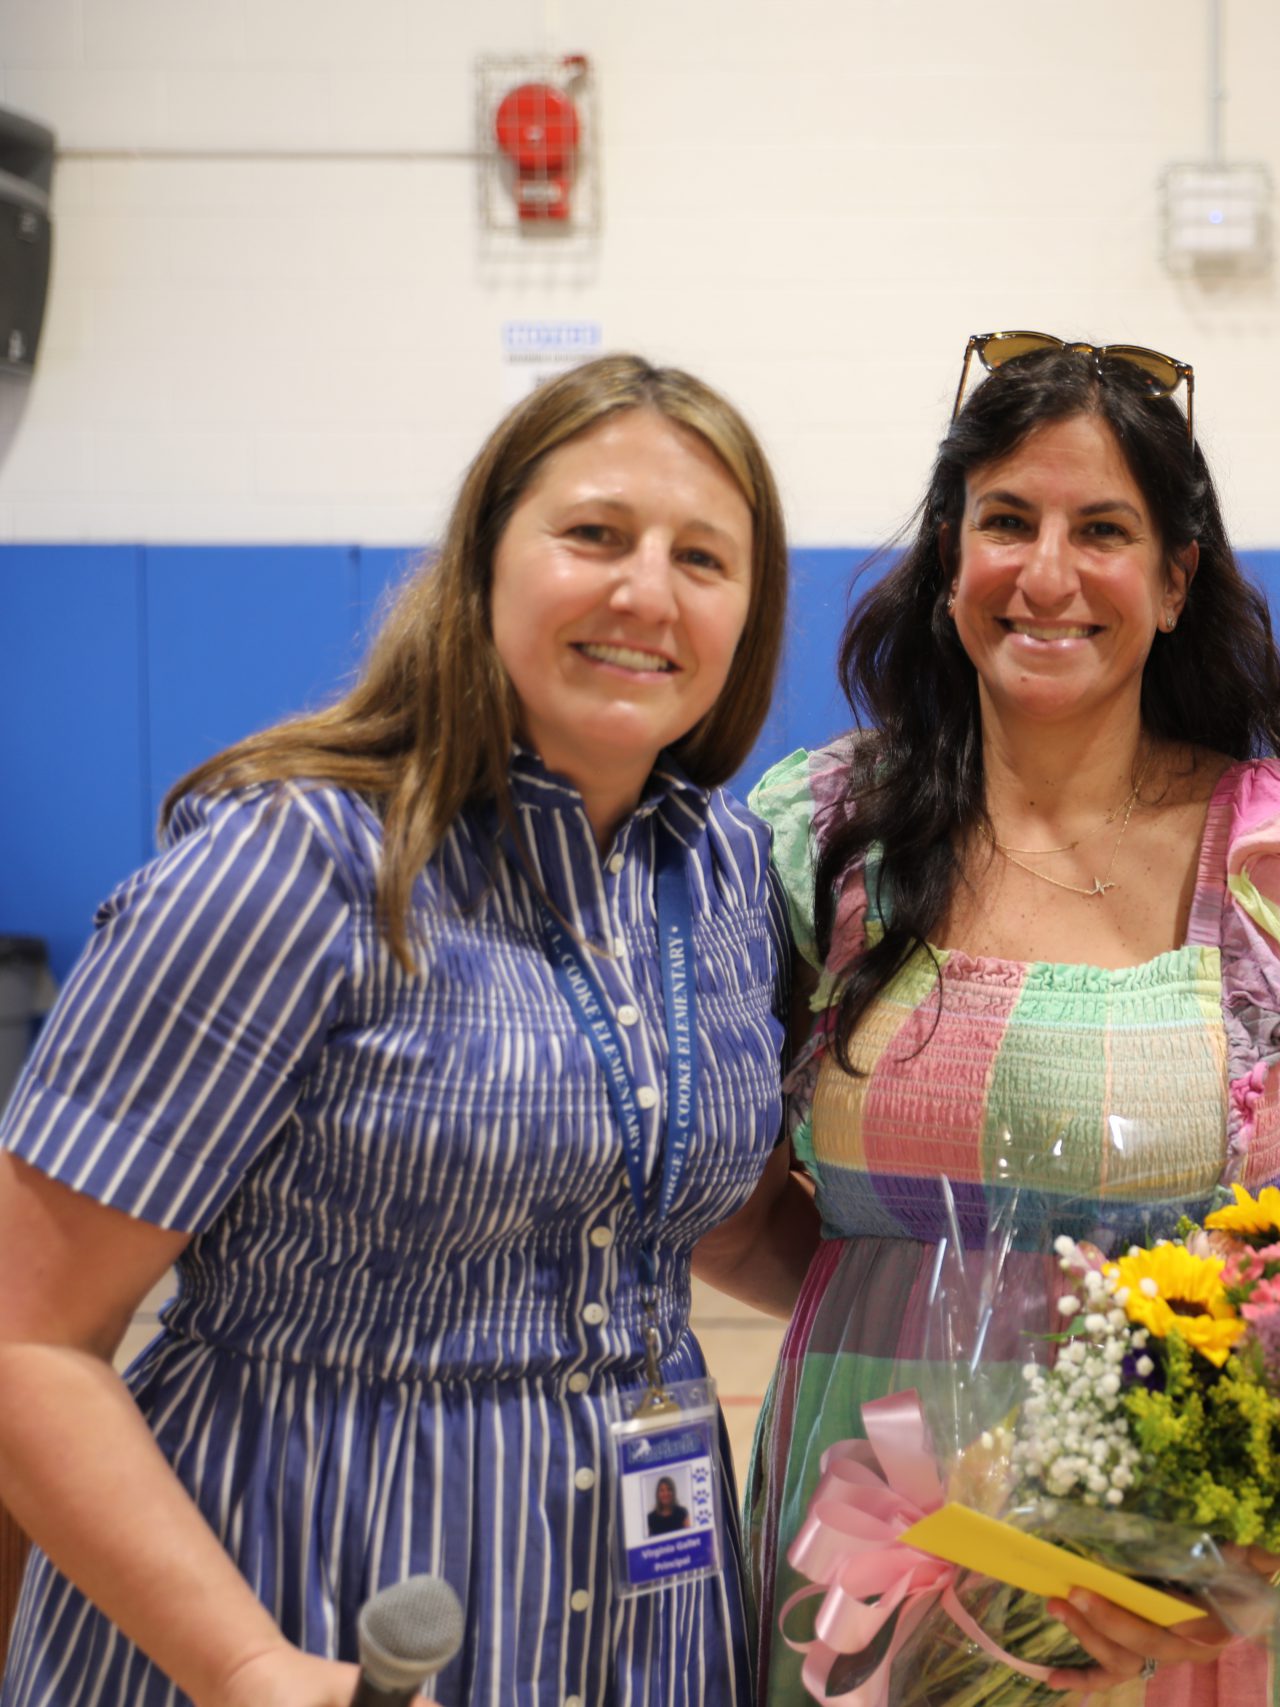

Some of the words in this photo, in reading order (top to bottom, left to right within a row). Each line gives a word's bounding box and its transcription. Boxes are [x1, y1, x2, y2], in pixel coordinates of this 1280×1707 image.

[560, 953, 603, 1018] COOKE
[591, 1019, 642, 1151] ELEMENTARY
[669, 937, 691, 1059] ELEMENTARY
[677, 1060, 691, 1129] COOKE
